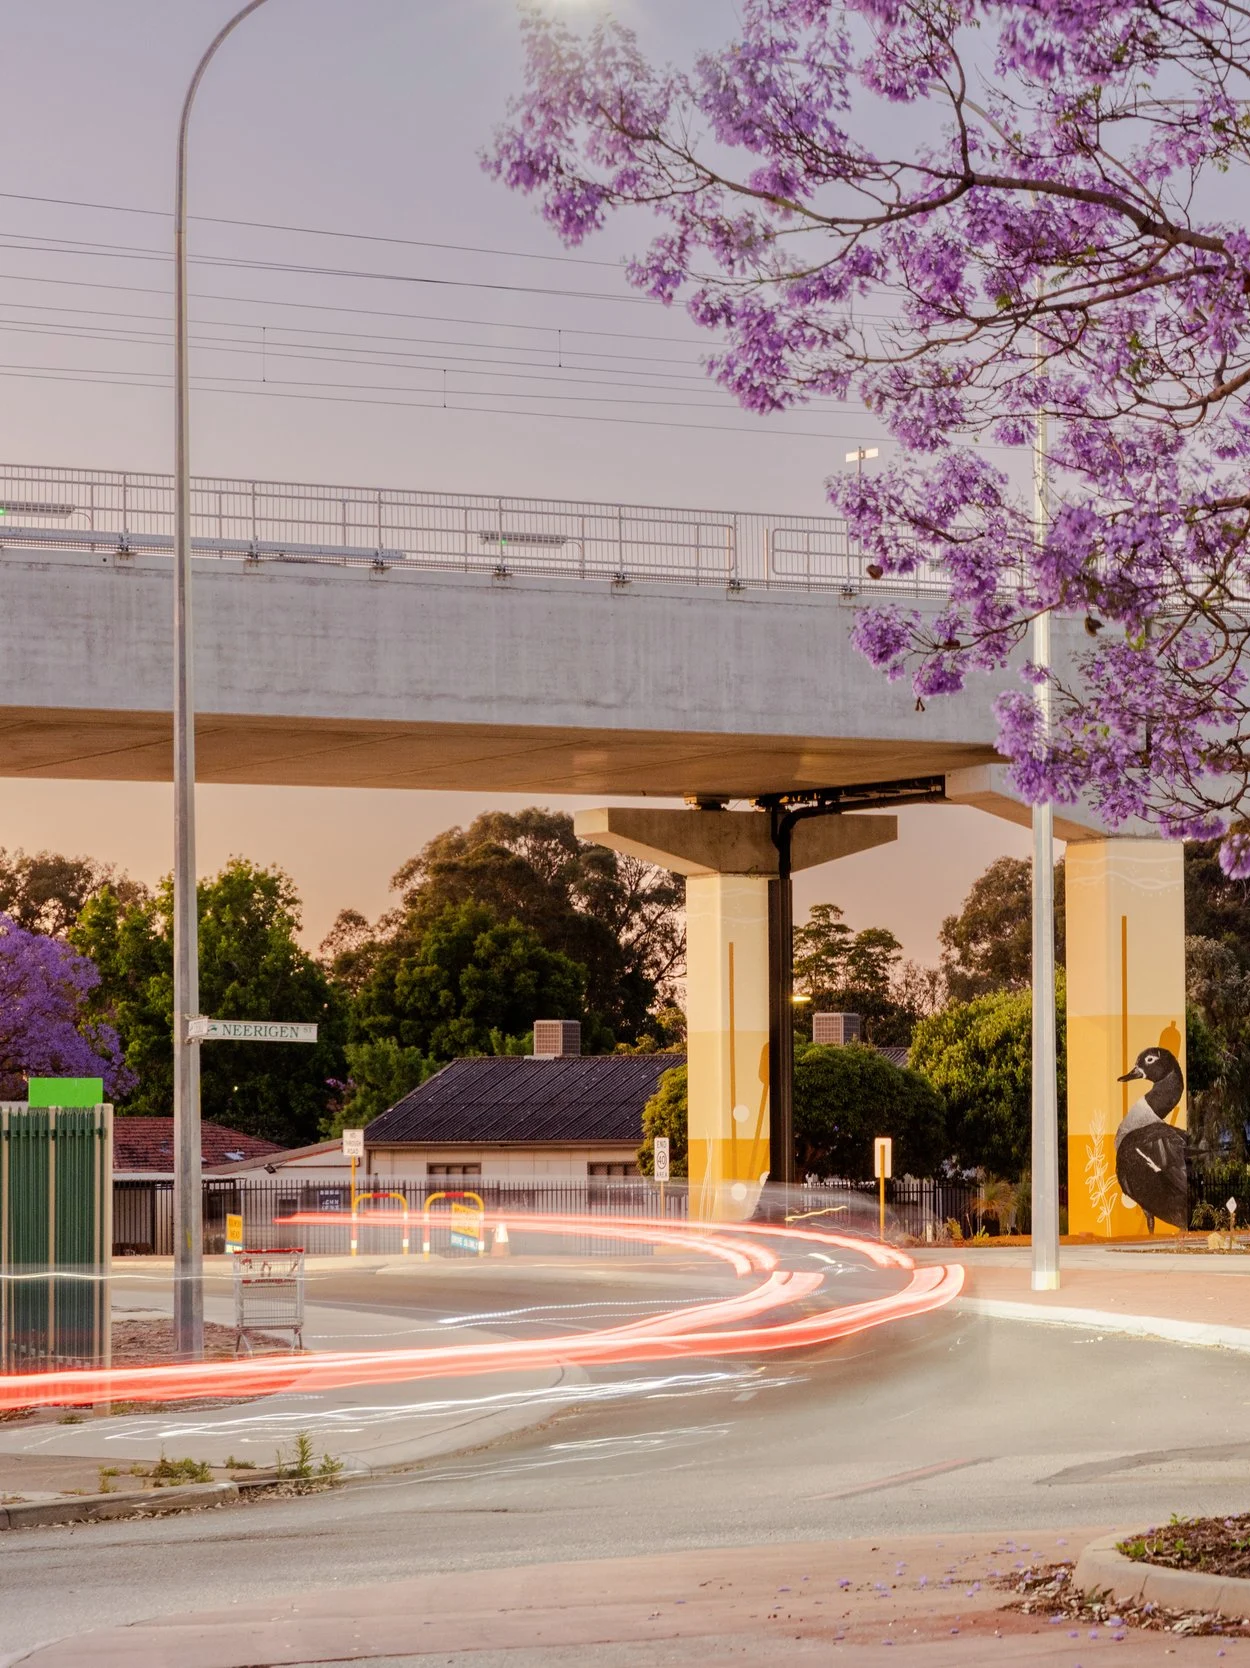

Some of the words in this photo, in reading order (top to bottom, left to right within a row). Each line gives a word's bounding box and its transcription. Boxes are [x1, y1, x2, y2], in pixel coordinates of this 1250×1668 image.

[222, 1024, 300, 1038] NEERIGEN
[656, 1140, 667, 1149] END
[658, 1155, 665, 1165] 40
